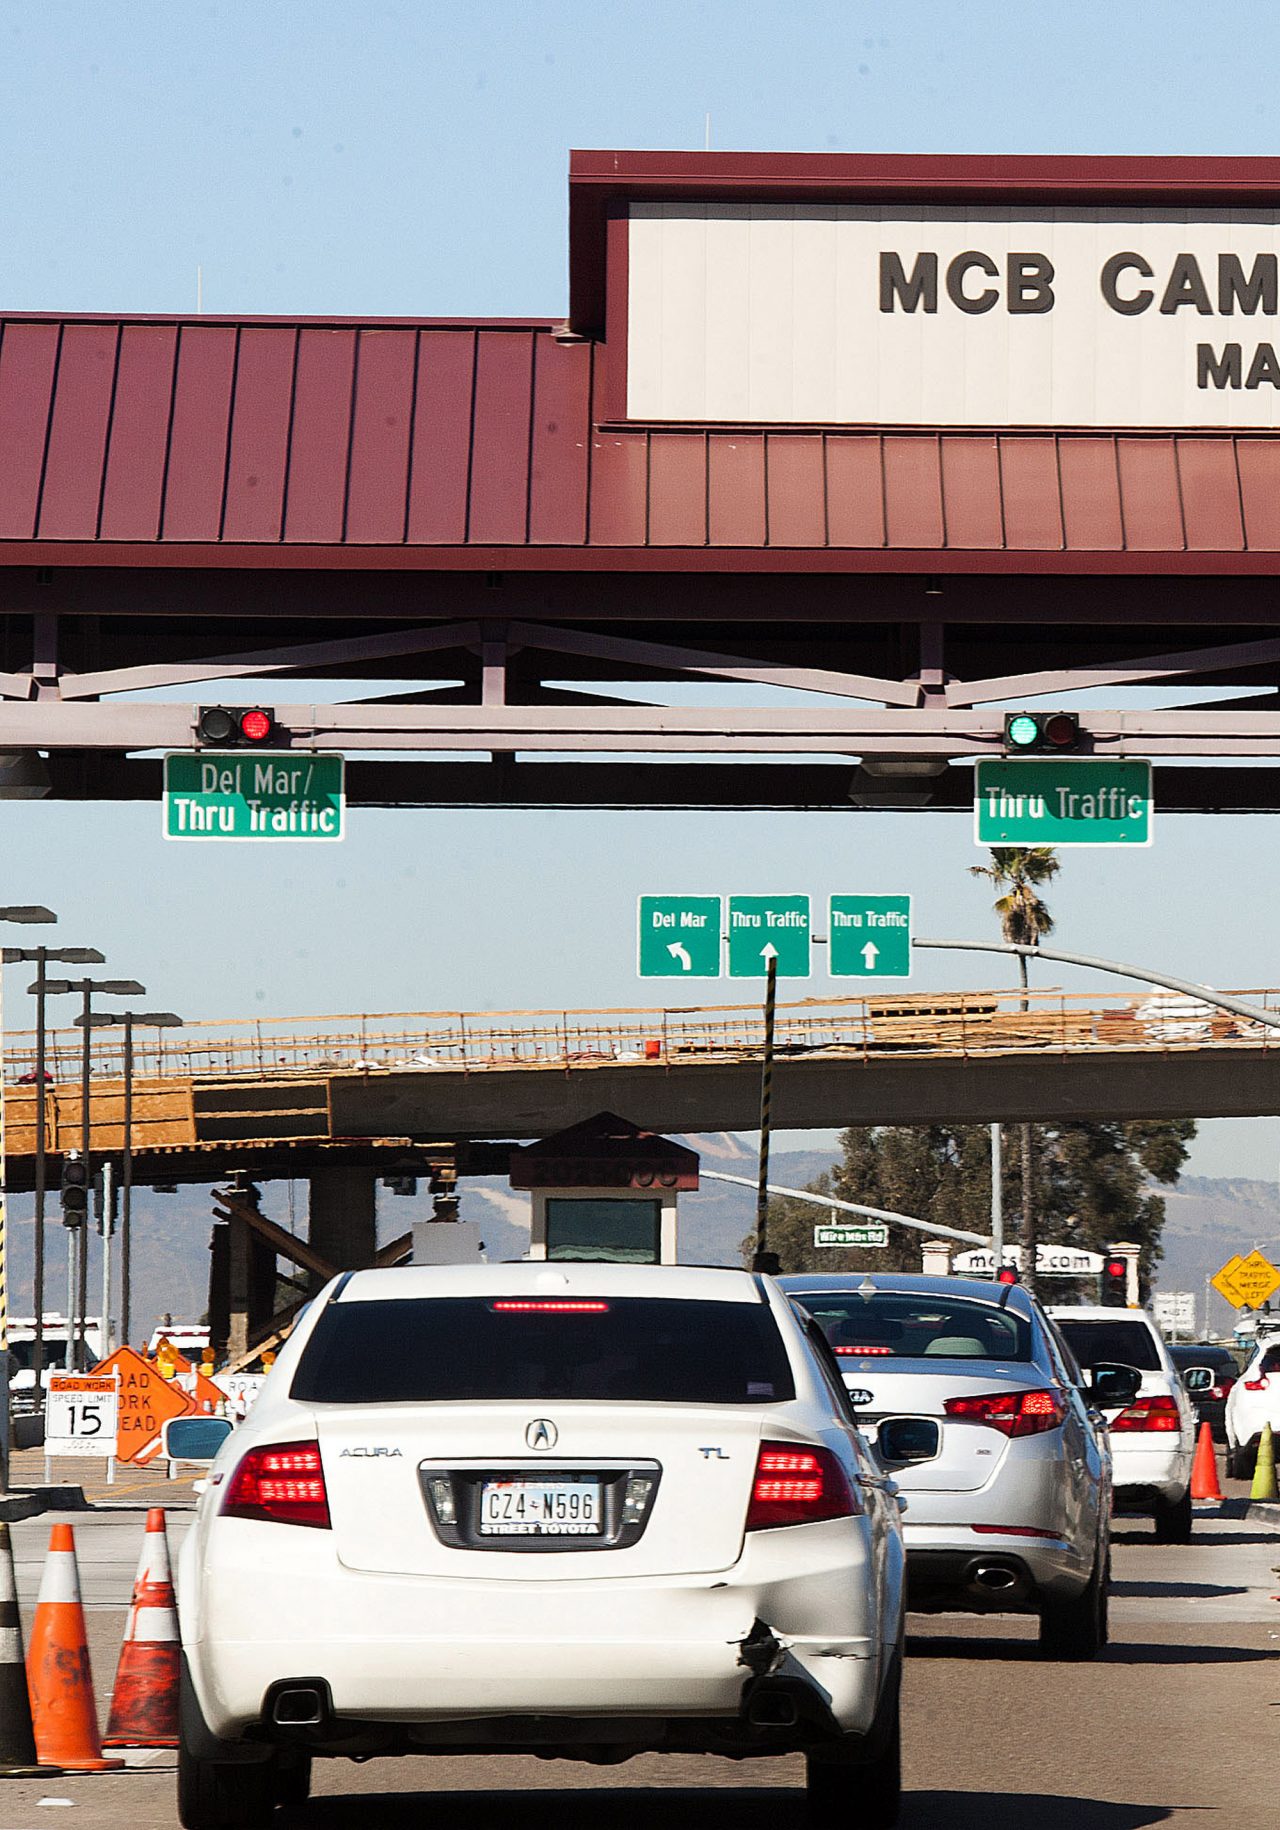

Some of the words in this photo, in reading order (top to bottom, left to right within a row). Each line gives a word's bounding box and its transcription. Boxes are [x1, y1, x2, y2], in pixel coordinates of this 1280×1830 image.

[879, 250, 1055, 315] MCB
[202, 763, 241, 794] Del
[254, 763, 313, 794] Mar/
[985, 786, 1045, 818] Thru
[1055, 787, 1143, 818] Traffic
[174, 798, 235, 831] Thru
[247, 799, 335, 832] Traffic
[652, 911, 676, 928] Del
[680, 912, 707, 928] Mar
[731, 911, 761, 928] Thru
[765, 911, 807, 928] Traffic
[832, 911, 862, 927] Thru
[866, 911, 908, 928] Traffic
[51, 1381, 80, 1391] ROAD
[83, 1381, 113, 1391] WORK
[118, 1373, 149, 1389] OAD
[52, 1394, 83, 1403] SPEED
[88, 1394, 113, 1403] LIMIT
[118, 1395, 151, 1409] ORK
[68, 1405, 102, 1435] 15
[119, 1415, 156, 1431] EAD
[339, 1447, 403, 1457] ACURA
[698, 1447, 730, 1459] TL
[481, 1523, 536, 1534] STREET
[540, 1522, 599, 1534] TOYOTA
